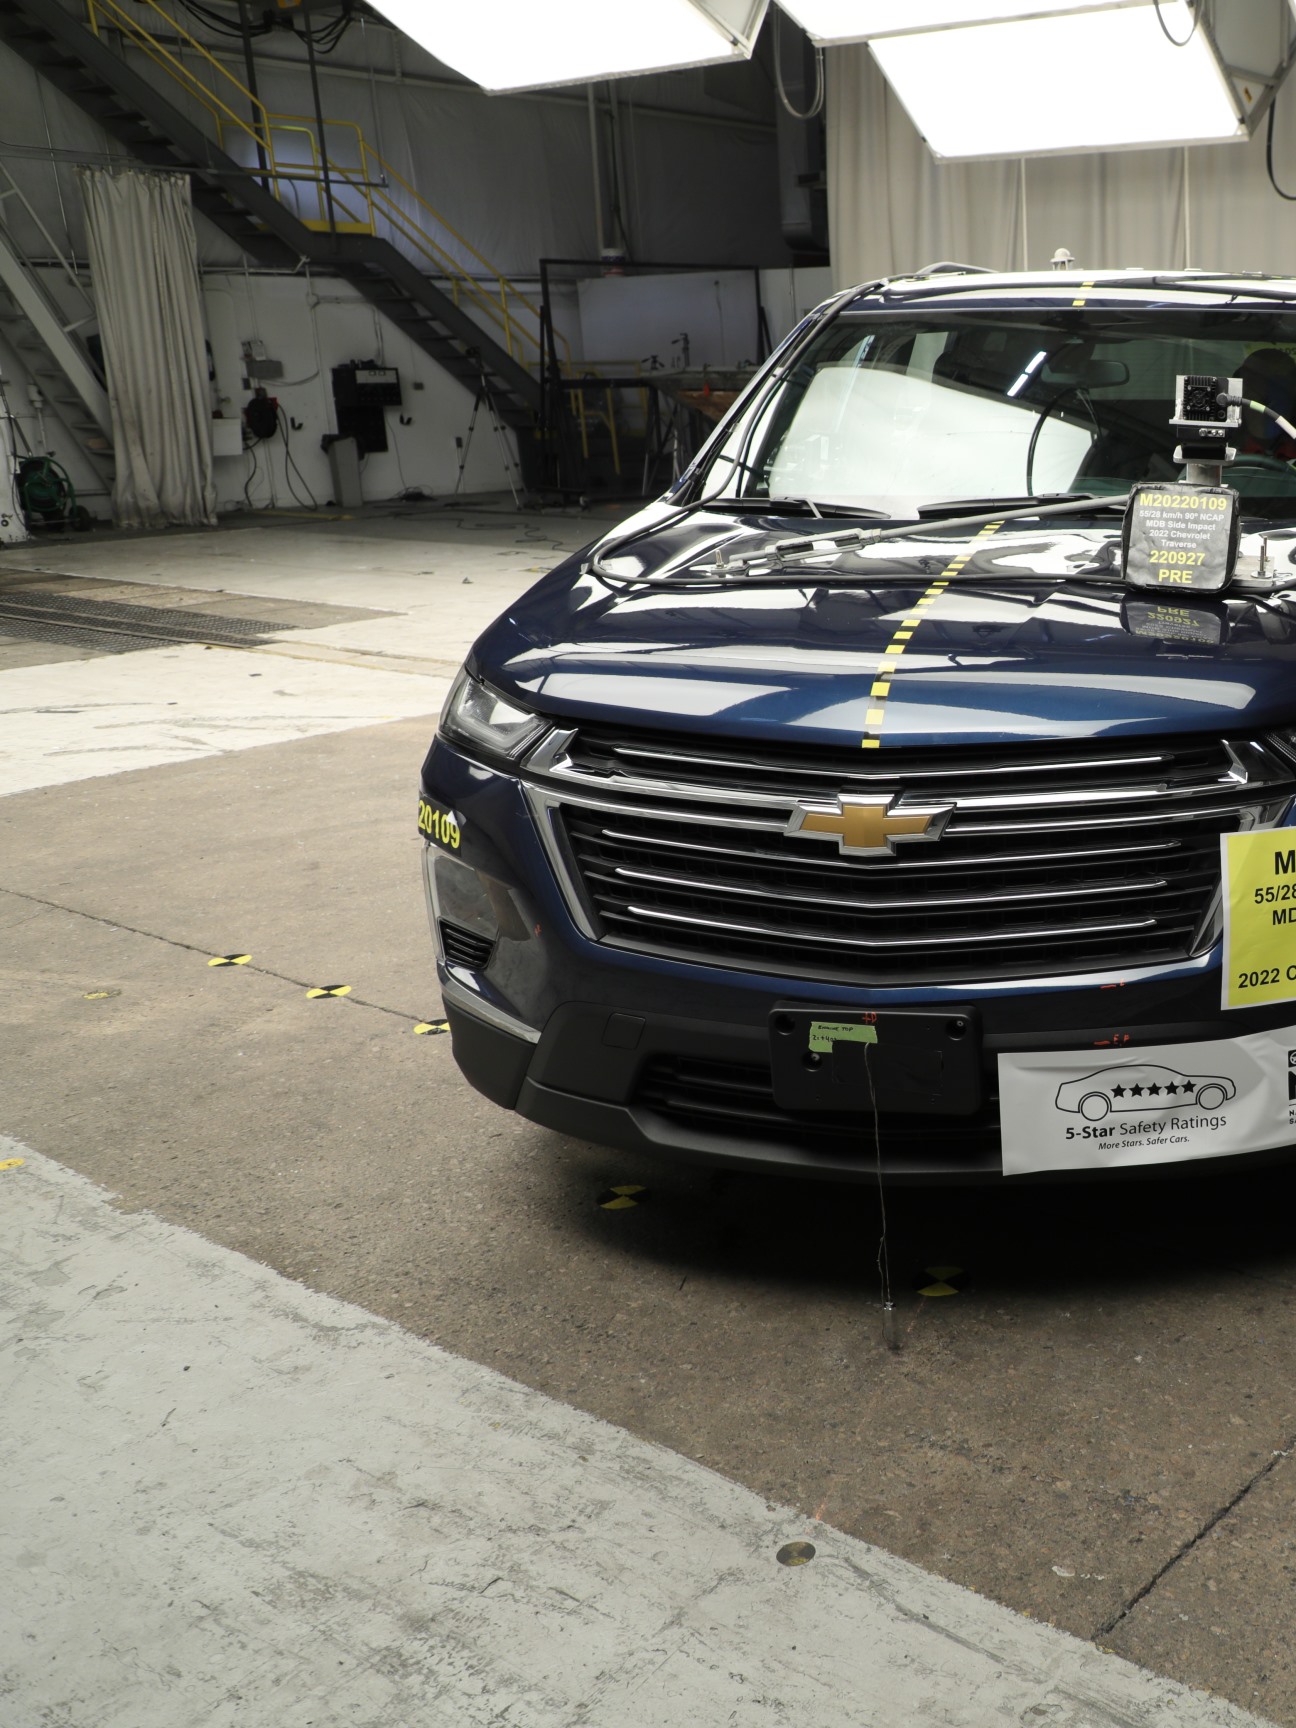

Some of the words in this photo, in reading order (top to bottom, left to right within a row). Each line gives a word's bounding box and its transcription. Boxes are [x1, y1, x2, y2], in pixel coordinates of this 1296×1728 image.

[1140, 493, 1227, 510] M20220109
[1139, 510, 1161, 518] 55/28
[1162, 511, 1183, 519] km/h
[1199, 513, 1225, 521] NCAP
[1145, 520, 1166, 528] MDB
[1167, 521, 1186, 529] Side
[1187, 522, 1216, 531] Impact
[1149, 529, 1169, 538] 2022
[1170, 530, 1211, 539] Chevrolet
[1161, 539, 1197, 549] Traverse
[1149, 550, 1206, 566] 220927
[1158, 569, 1193, 584] PRE
[1238, 967, 1280, 989] 2022
[1065, 1125, 1116, 1140] 5-Star
[1119, 1121, 1167, 1136] Safety
[1170, 1115, 1227, 1130] Ratings
[1098, 1141, 1120, 1150] More
[1121, 1139, 1145, 1148] Stars.
[1146, 1136, 1168, 1146] Safer
[1169, 1134, 1190, 1144] Cars.
